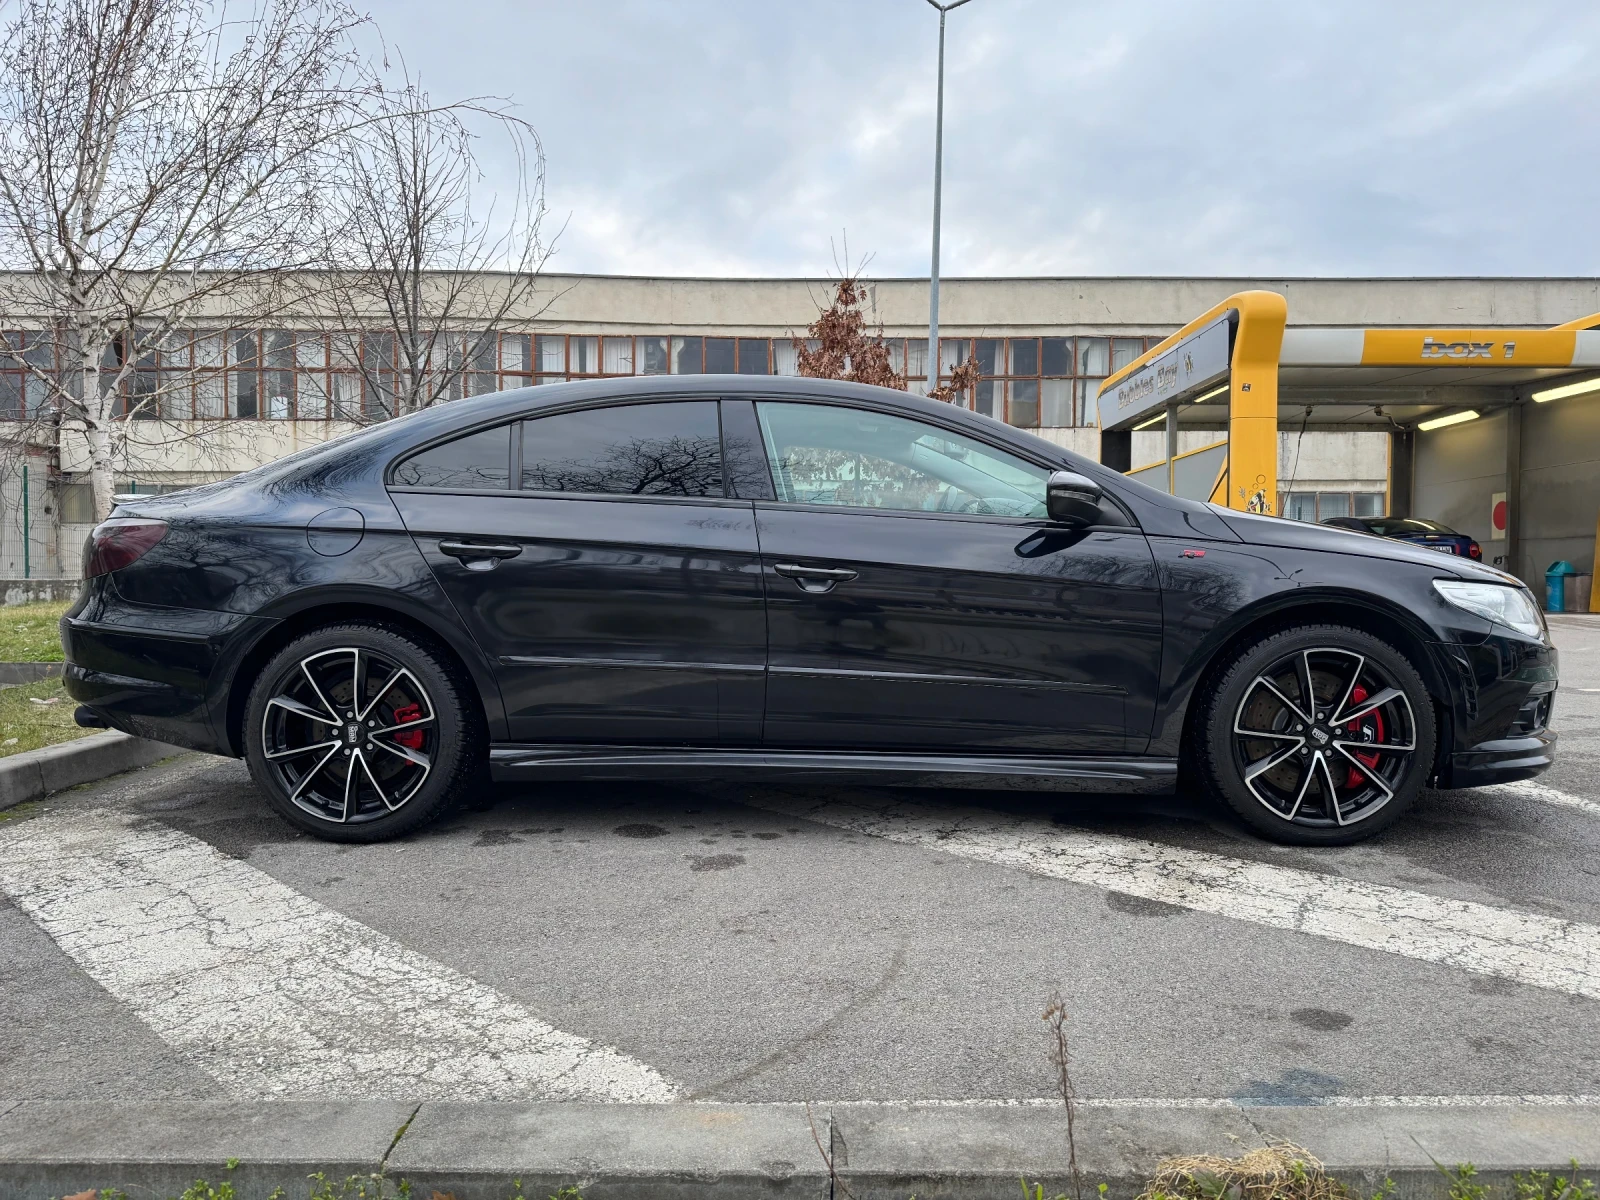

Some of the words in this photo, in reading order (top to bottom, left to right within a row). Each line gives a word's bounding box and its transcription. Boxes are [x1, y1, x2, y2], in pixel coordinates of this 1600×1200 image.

[1421, 336, 1495, 358] box
[1503, 341, 1516, 358] 1
[1157, 362, 1178, 389] Bay
